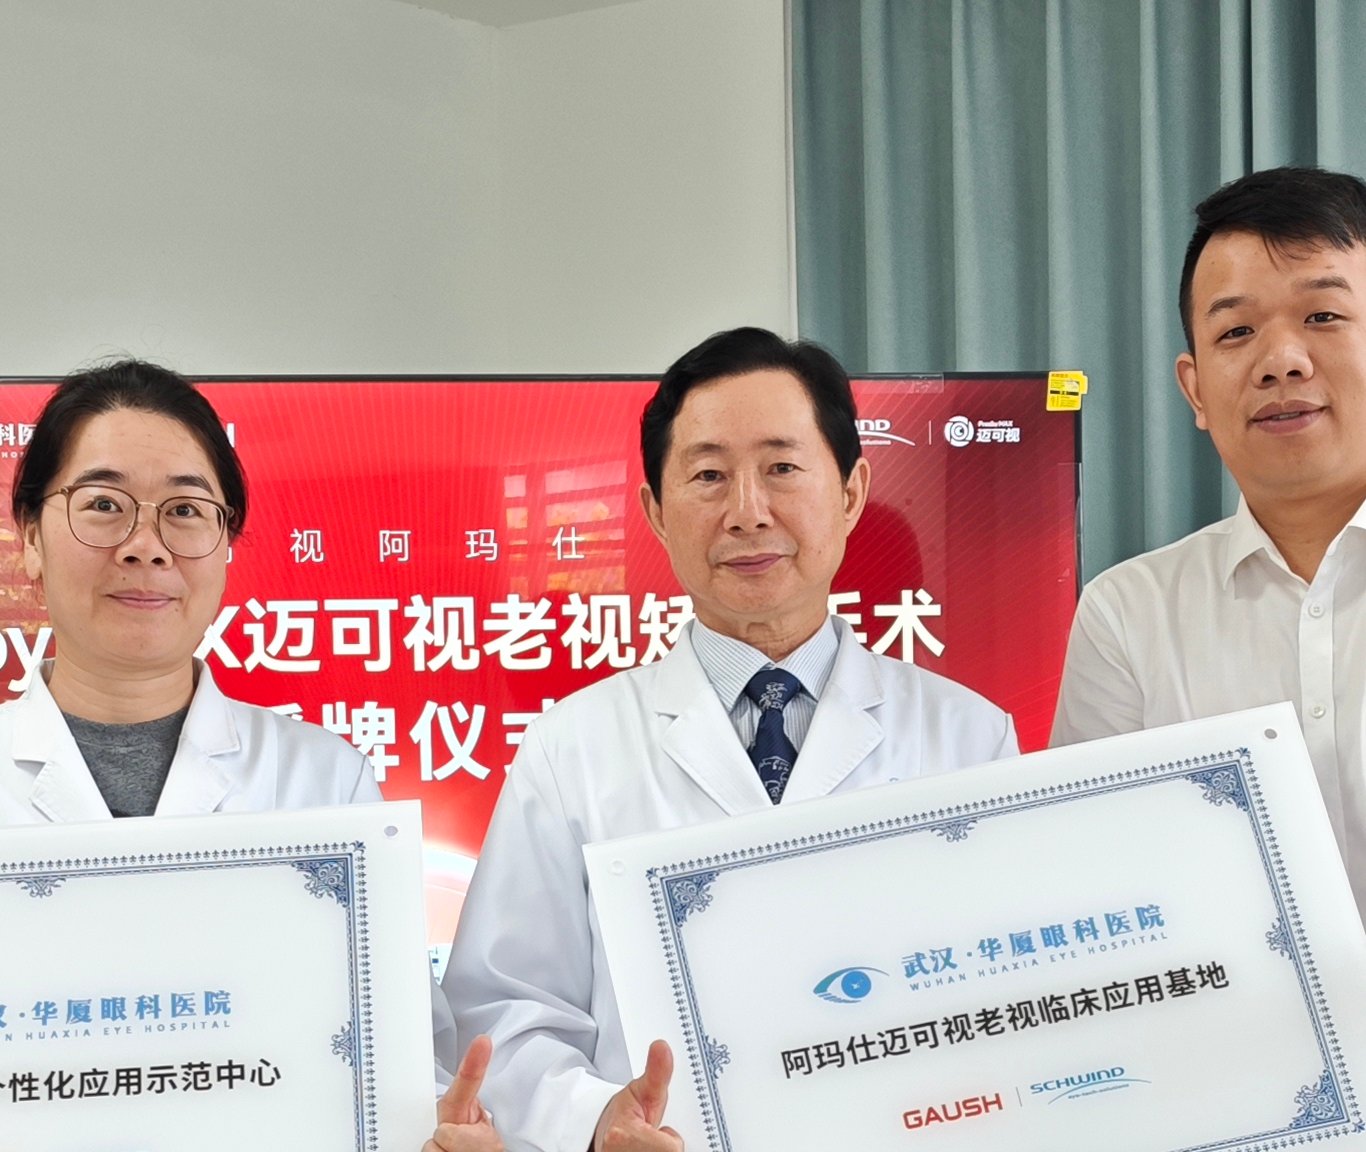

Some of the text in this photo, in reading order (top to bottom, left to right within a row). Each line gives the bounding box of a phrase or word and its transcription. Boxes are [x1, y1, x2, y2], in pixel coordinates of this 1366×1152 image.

[976, 428, 1021, 442] 迈可视
[909, 932, 1169, 992] WUHAN HUAXIA EYE HOSPITAL
[25, 1028, 91, 1041] HUAXIA
[103, 1025, 133, 1036] EYE
[144, 1019, 231, 1033] HOSPITAL
[780, 960, 1231, 1080] 阿玛仕迈可视老视临床应用基地
[902, 1066, 1126, 1130] GAUSH SCHWIND
